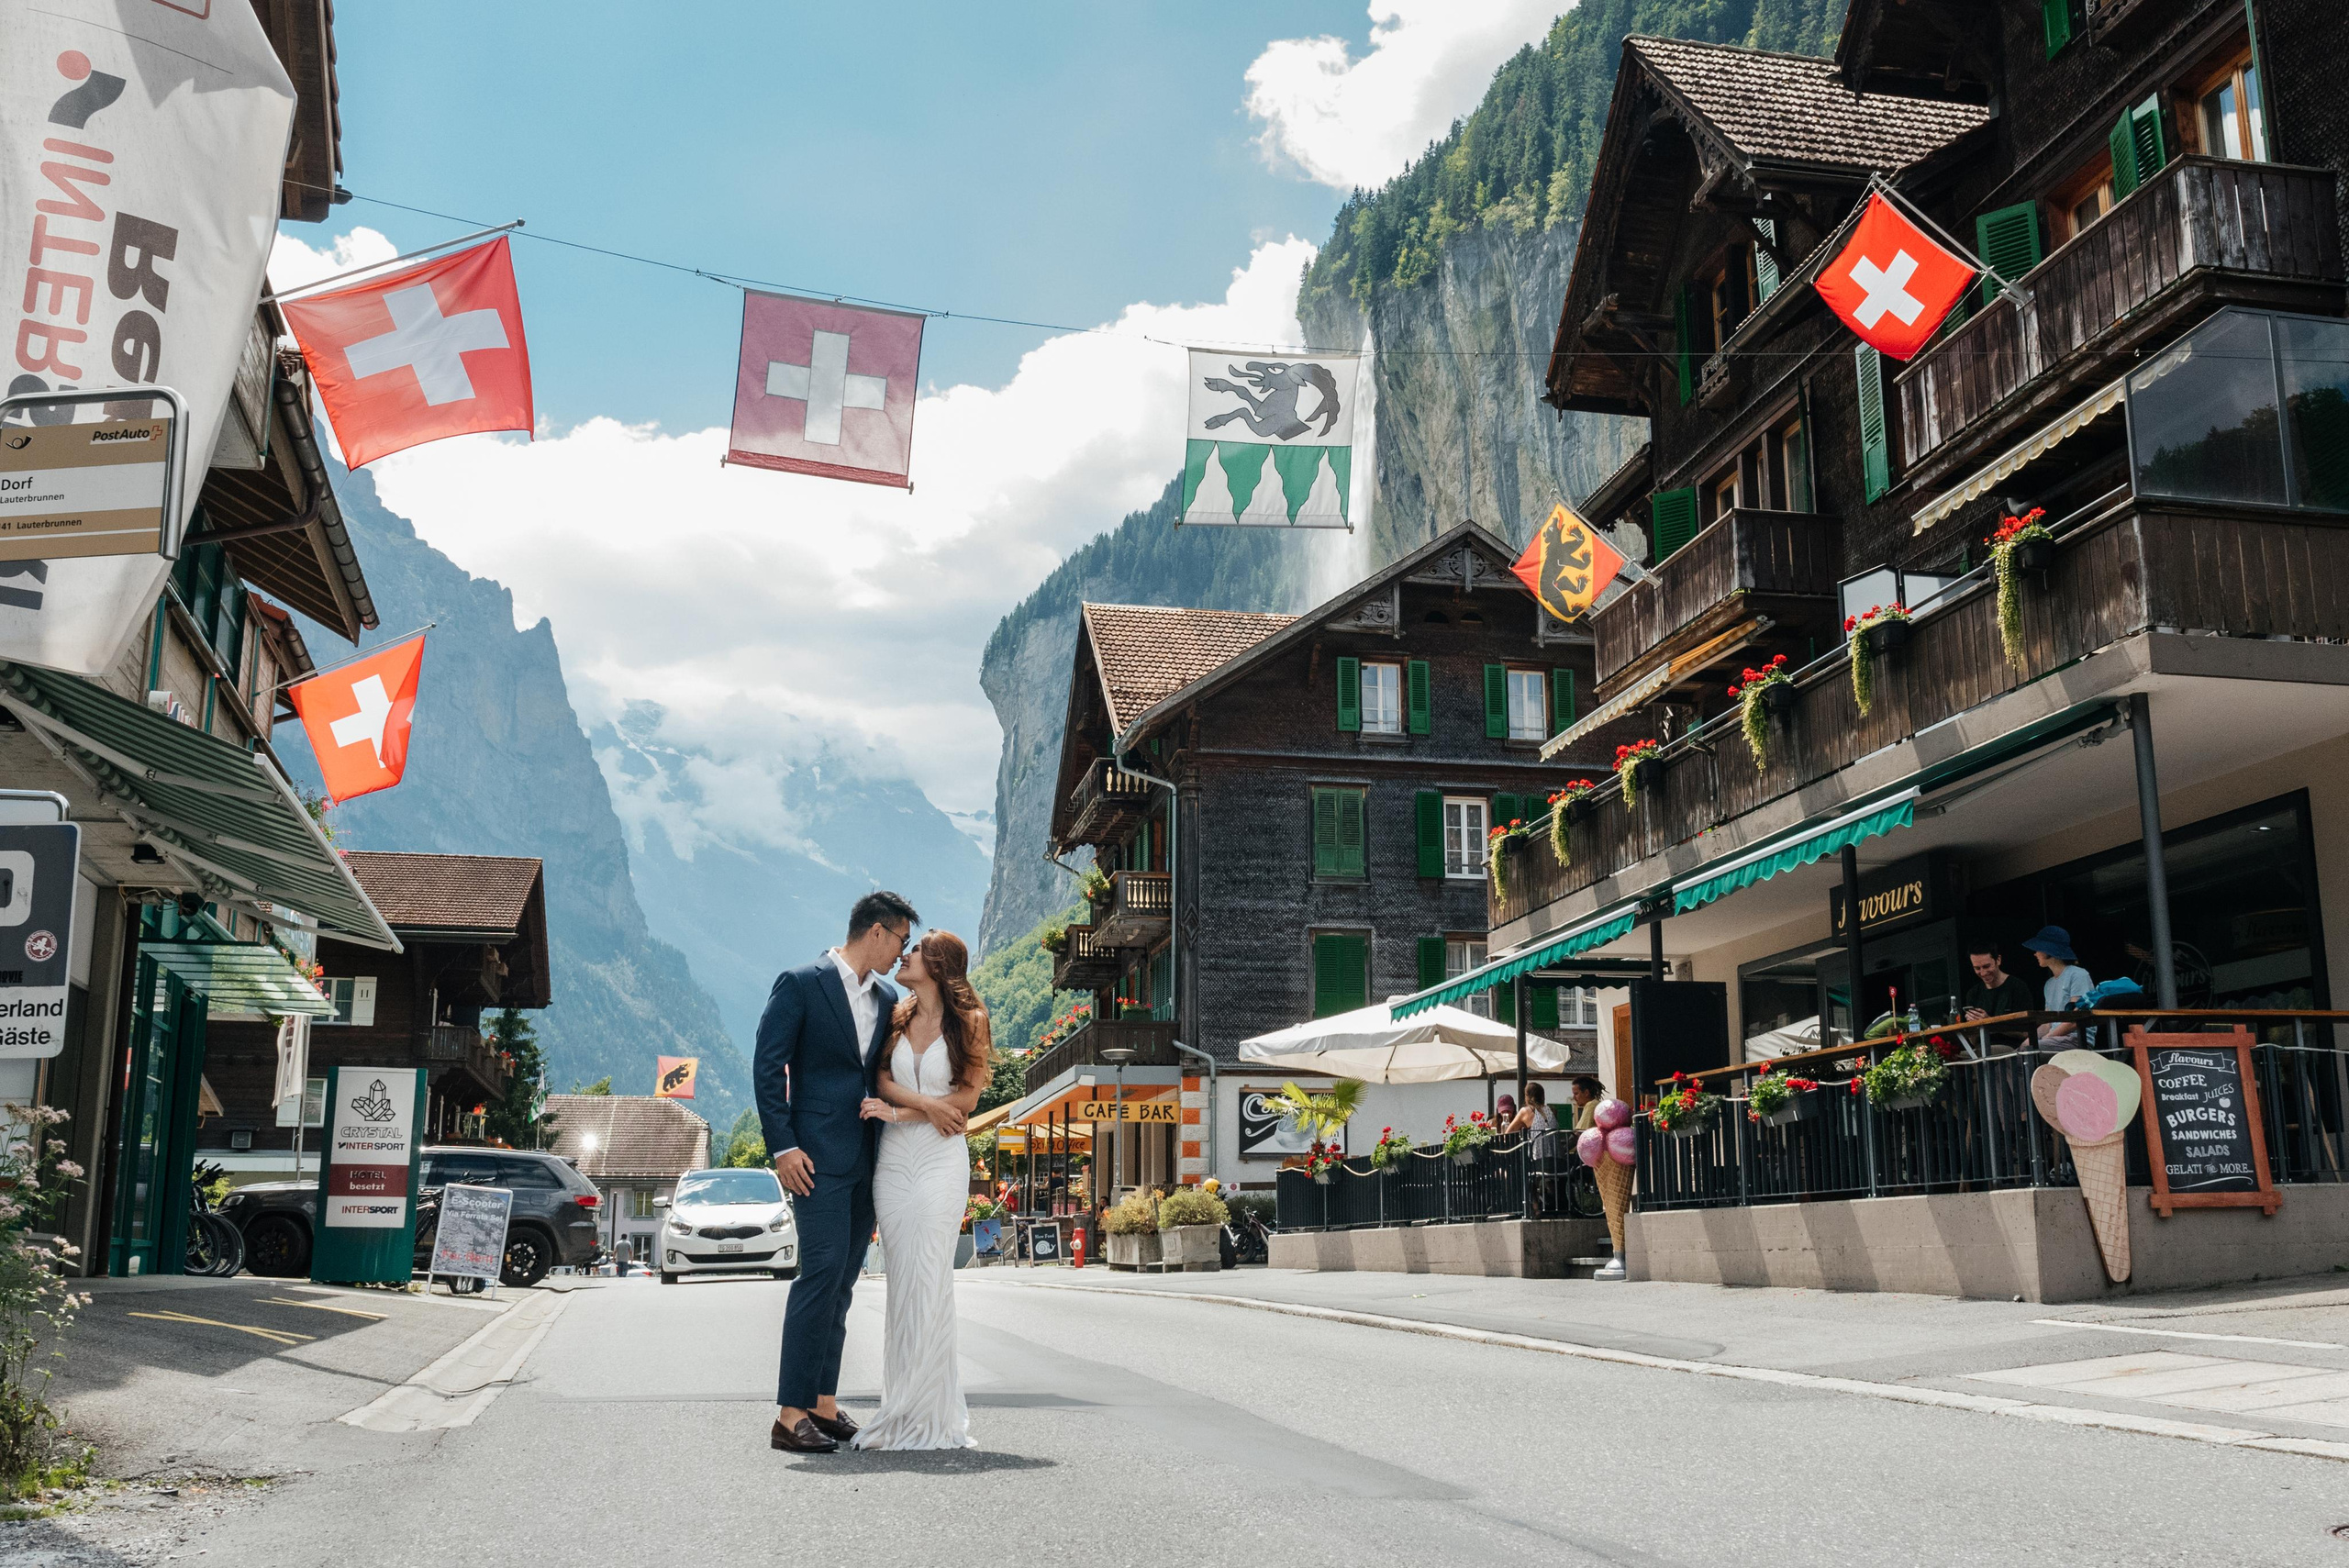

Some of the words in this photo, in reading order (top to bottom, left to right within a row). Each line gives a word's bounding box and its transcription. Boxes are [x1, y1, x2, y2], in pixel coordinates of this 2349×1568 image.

[92, 428, 150, 441] PostAuto
[1, 477, 33, 491] Dorf
[0, 493, 64, 504] Lauterbrunnen
[0, 522, 12, 530] 41
[17, 519, 82, 529] Lauterbrunnen
[0, 1027, 50, 1046] äste
[2168, 1052, 2214, 1066] flavours
[2157, 1074, 2207, 1089] COFFEE
[2161, 1093, 2199, 1101] Breakfast
[2203, 1083, 2234, 1103] JUICES
[1084, 1103, 1130, 1119] CAFÉ
[1140, 1105, 1174, 1119] BAR
[2166, 1107, 2236, 1128] BURGERS
[340, 1127, 403, 1139] CRYSTAL
[2171, 1129, 2237, 1140] SANDWICHES
[2186, 1145, 2231, 1158] SALADS
[350, 1171, 386, 1179] HOTEL
[2165, 1164, 2202, 1174] GELATI
[350, 1183, 385, 1191] besetzt
[451, 1196, 504, 1209] E-Scooter
[342, 1206, 398, 1215] INTERSPORT
[447, 1209, 459, 1218] Via
[461, 1211, 488, 1220] Ferrata
[490, 1214, 503, 1222] Set
[465, 1251, 494, 1263] Rent
